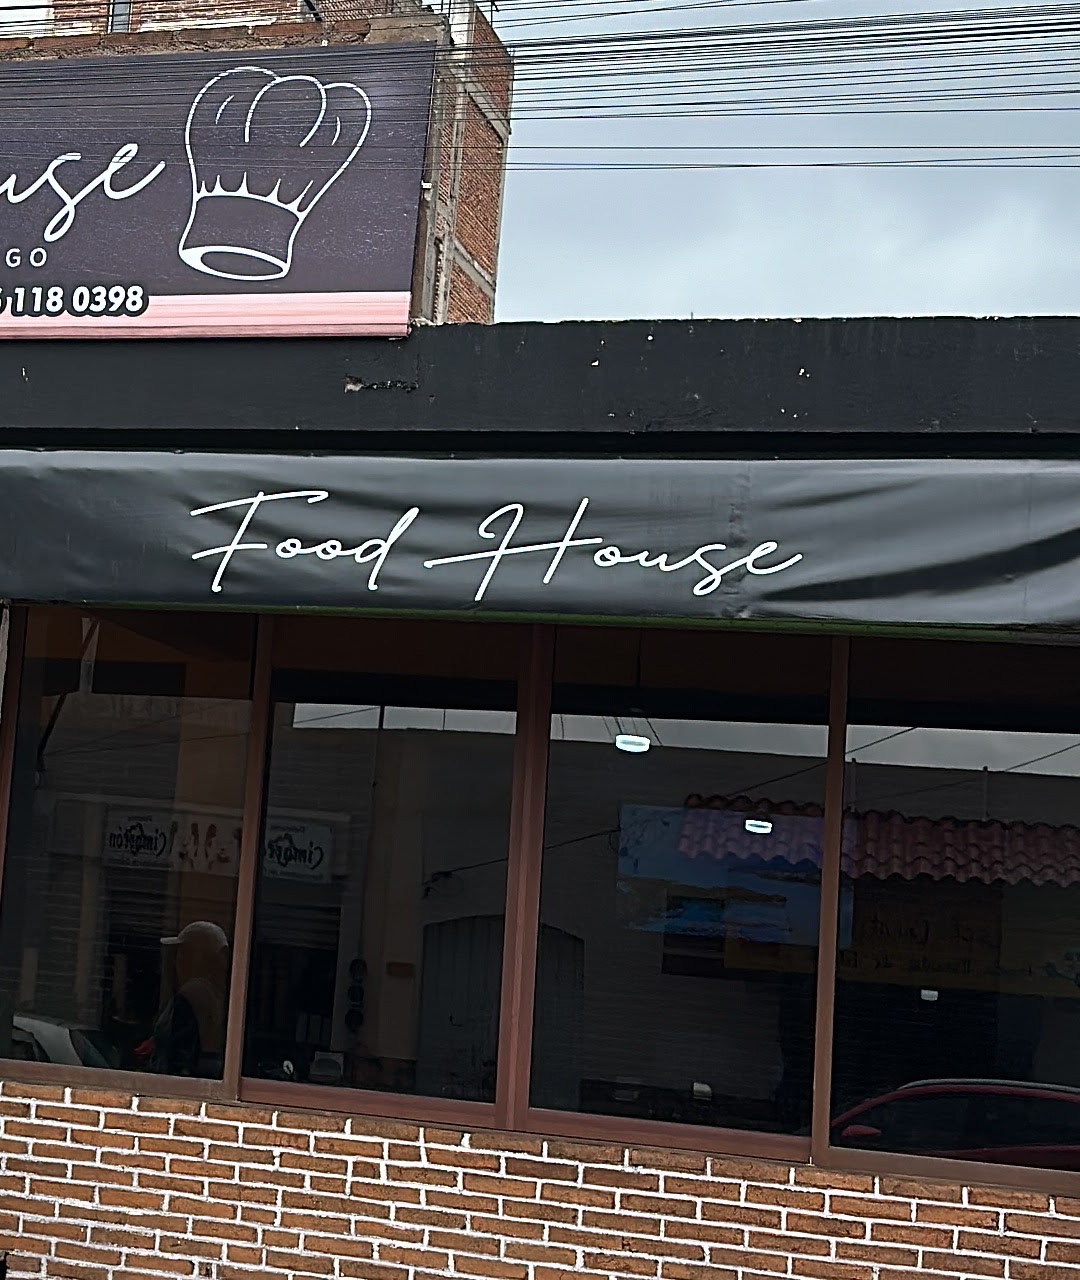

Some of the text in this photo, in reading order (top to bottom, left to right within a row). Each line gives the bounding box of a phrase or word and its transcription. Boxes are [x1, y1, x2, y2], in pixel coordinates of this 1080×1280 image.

[13, 286, 64, 313] 118
[72, 285, 144, 313] 0398
[190, 490, 803, 601] Food House
